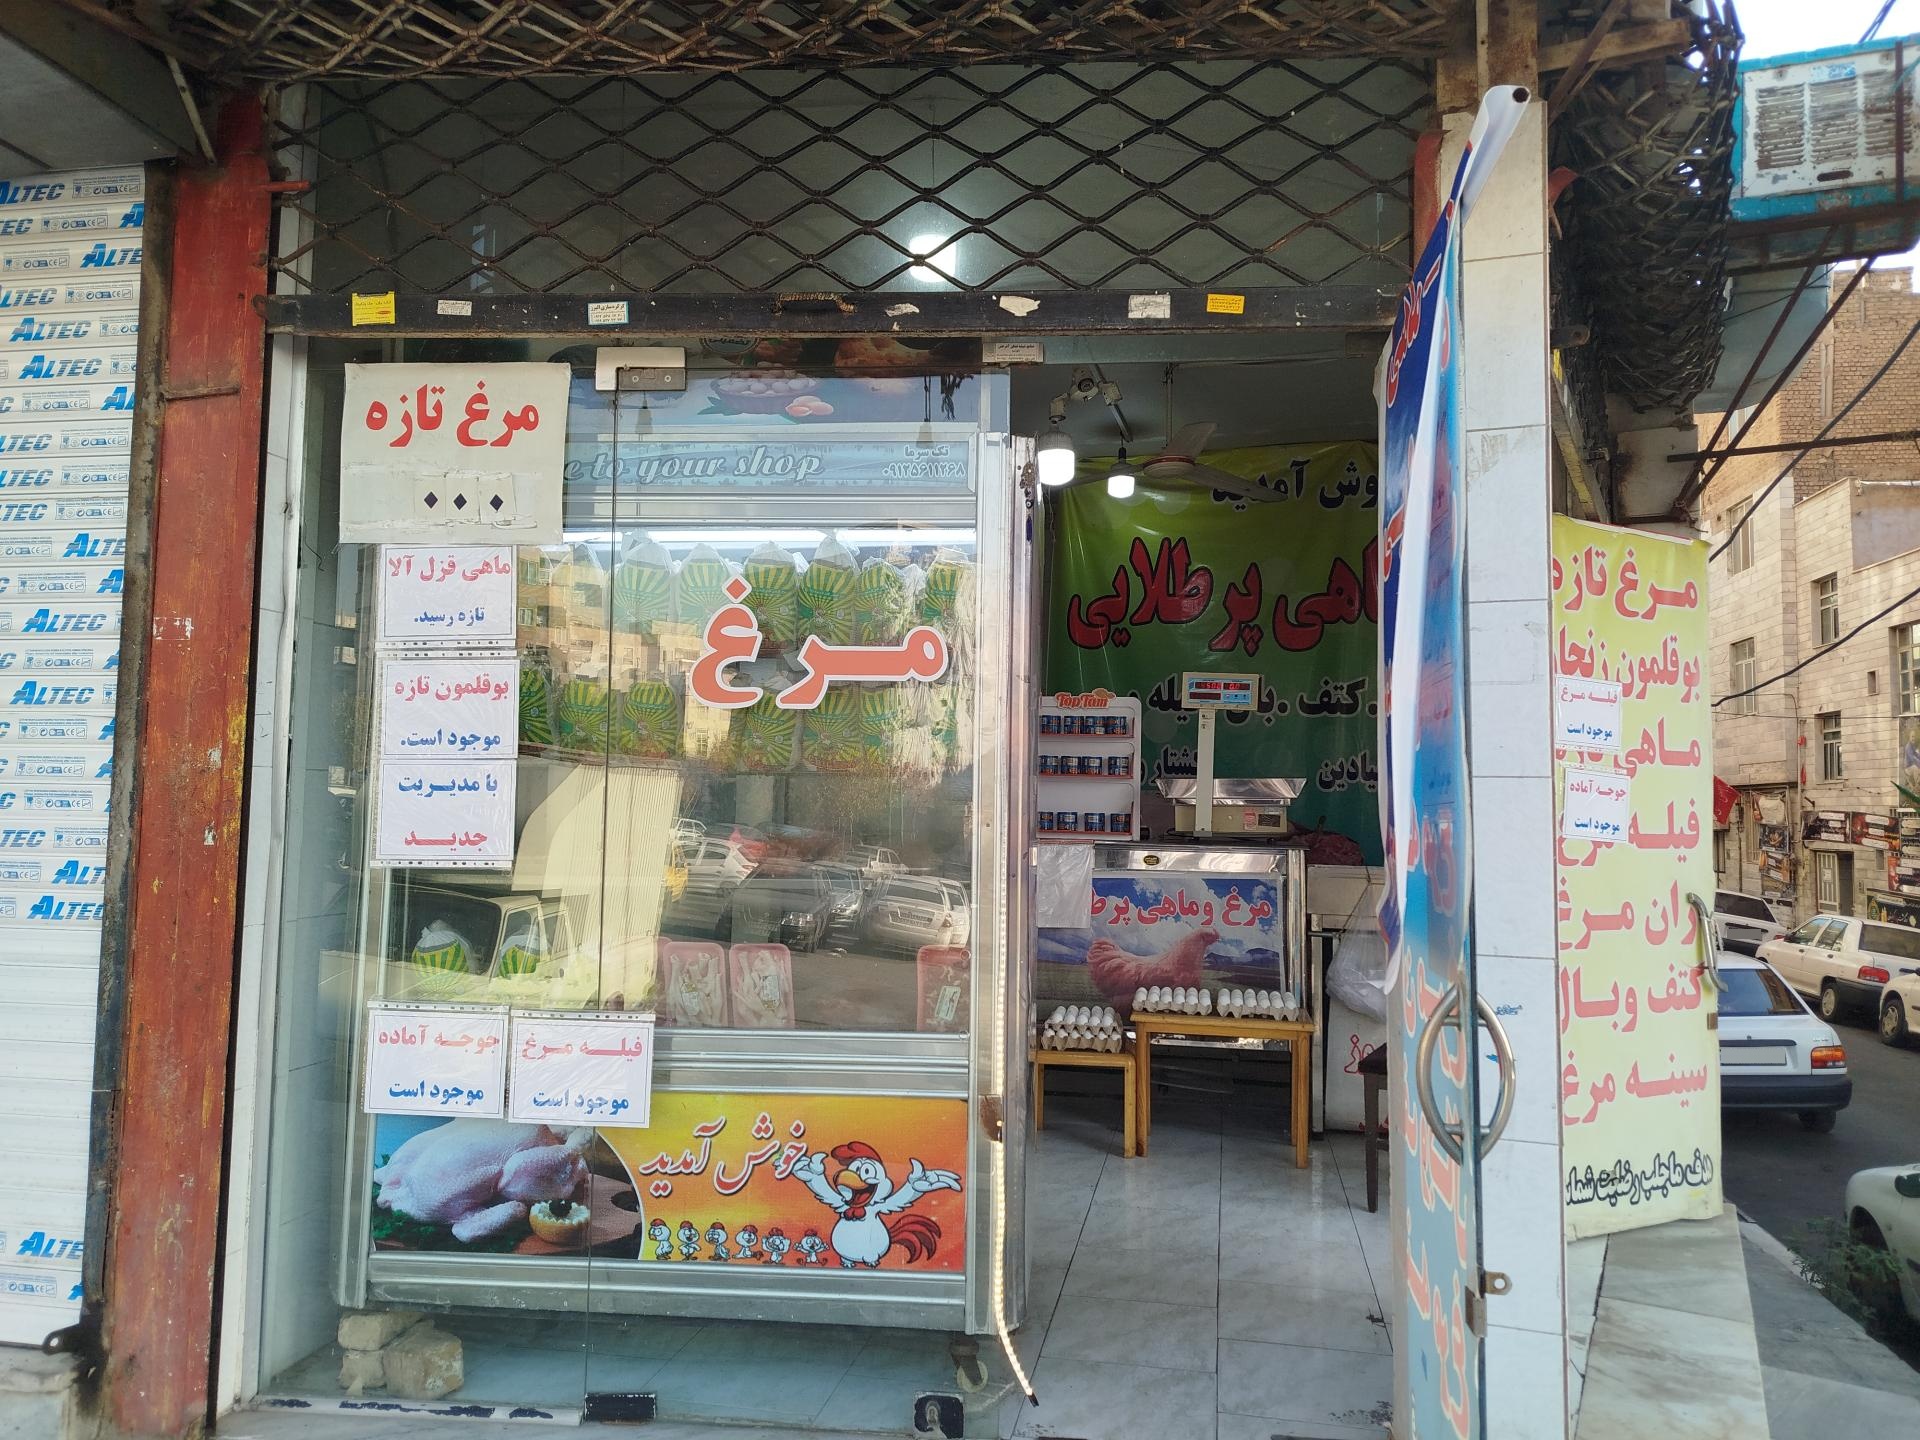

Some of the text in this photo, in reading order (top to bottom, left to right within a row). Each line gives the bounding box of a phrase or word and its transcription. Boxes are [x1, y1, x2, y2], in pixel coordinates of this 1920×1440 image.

[80, 243, 142, 267] ALTE
[0, 287, 57, 308] LTEC
[9, 317, 91, 342] ALTEC
[18, 355, 103, 379] ALTEC
[365, 381, 539, 448] مرغ تازه
[590, 453, 628, 480] to
[636, 456, 724, 484] your
[733, 445, 825, 481] shop
[1319, 461, 1378, 509] وش
[63, 533, 125, 557] ALTE
[387, 554, 511, 583] ماهی قزل آلا
[1066, 530, 1378, 657] اهی پر طلایی
[1614, 548, 1698, 620] مرغ
[21, 609, 106, 632] ALTEC
[458, 606, 485, 627] تازه
[690, 577, 948, 710] مرغ
[9, 681, 94, 705] ALTEC
[395, 673, 509, 702] بوقلمون تازه
[1148, 674, 1199, 723] یله
[1299, 677, 1368, 716] کتف
[1561, 684, 1618, 707] فیله مرغ
[448, 730, 501, 752] موجود
[1567, 722, 1612, 741] موجود است
[1317, 752, 1378, 790] یادین
[399, 774, 498, 798] با مدیریت
[1570, 779, 1627, 801] جوجه آماده
[404, 829, 488, 852] جدید
[1574, 817, 1620, 835] موجود است
[1627, 797, 1700, 863] فیله
[1107, 896, 1131, 927] پر
[1223, 885, 1272, 926] مرغ
[1645, 878, 1697, 946] ران
[1648, 962, 1702, 1014] کتف
[378, 1024, 500, 1055] جوجه آماده
[521, 1032, 644, 1062] فیله مرغ
[388, 1079, 484, 1107] موجود است
[533, 1089, 629, 1116] موجود است
[1563, 1050, 1708, 1126] سینه مرغ
[639, 1112, 808, 1197] خوش آمدید
[16, 1231, 83, 1259] ALTE
